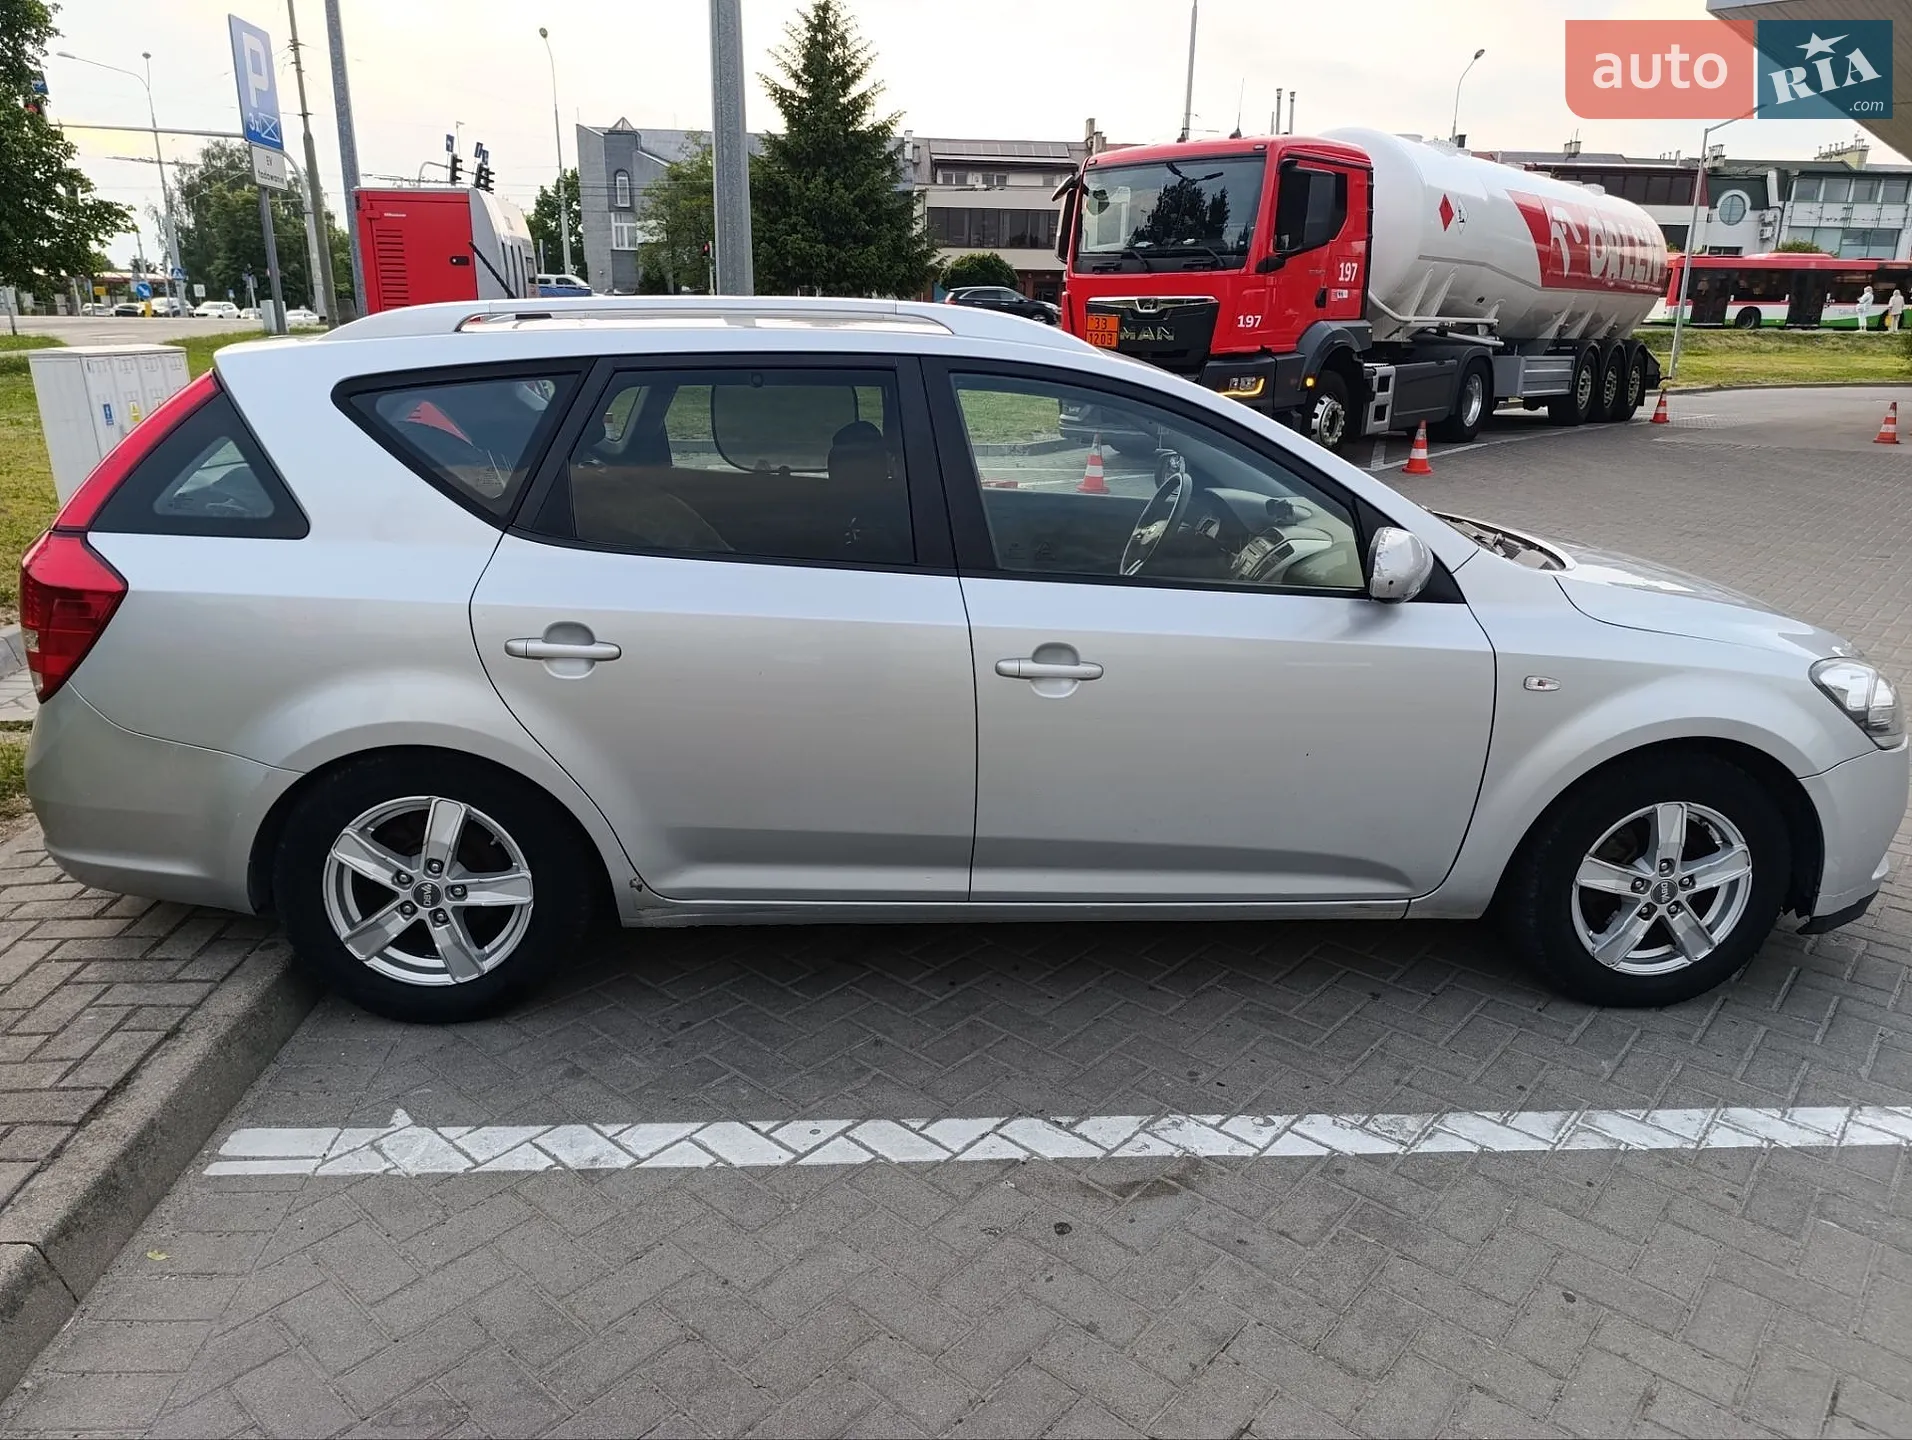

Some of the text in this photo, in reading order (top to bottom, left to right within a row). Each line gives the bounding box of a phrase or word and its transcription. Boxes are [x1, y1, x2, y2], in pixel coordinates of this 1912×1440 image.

[242, 31, 269, 108] P
[1338, 262, 1358, 282] 197
[1094, 317, 1107, 330] 33
[1237, 314, 1262, 328] 197
[1089, 333, 1113, 345] 1203
[1120, 326, 1175, 341] MAN
